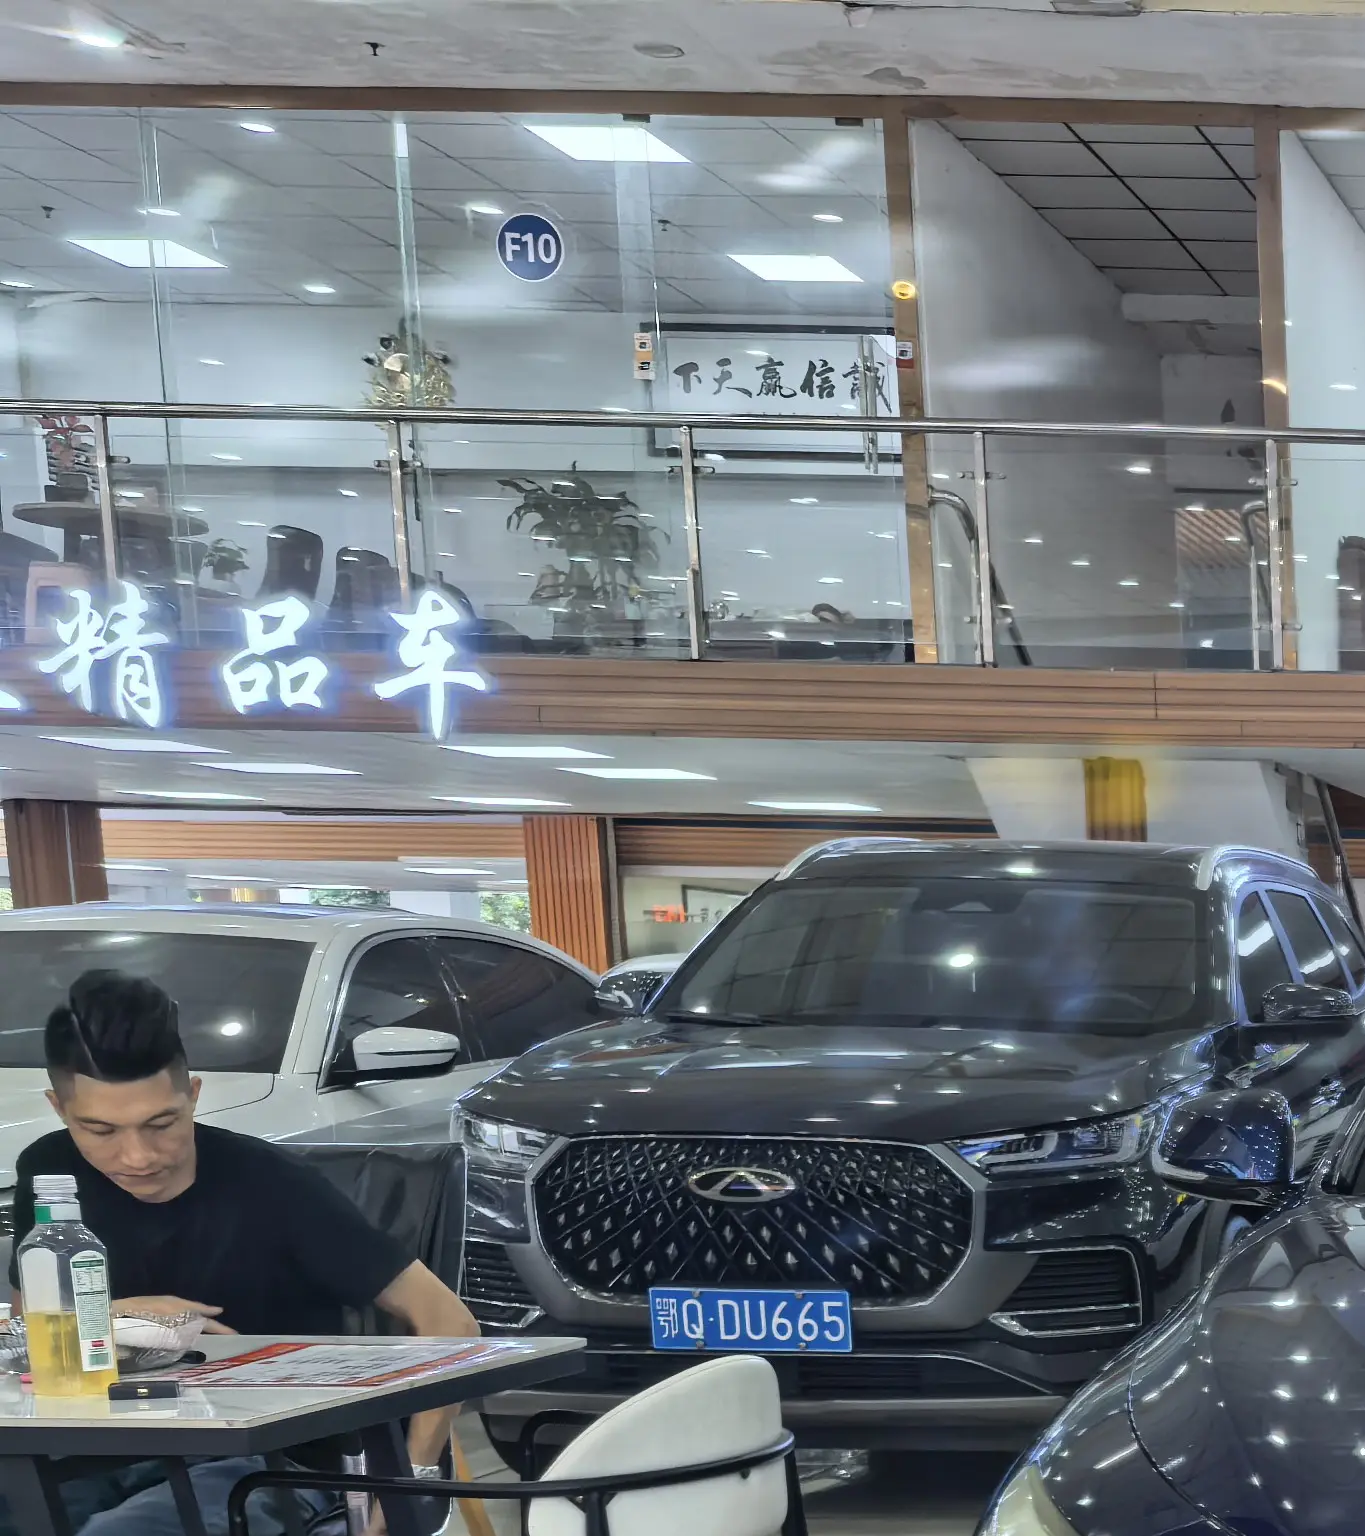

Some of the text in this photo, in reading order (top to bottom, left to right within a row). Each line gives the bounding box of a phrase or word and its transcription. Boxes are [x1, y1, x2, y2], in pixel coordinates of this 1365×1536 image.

[504, 232, 557, 263] F10
[0, 580, 489, 740] 精品车
